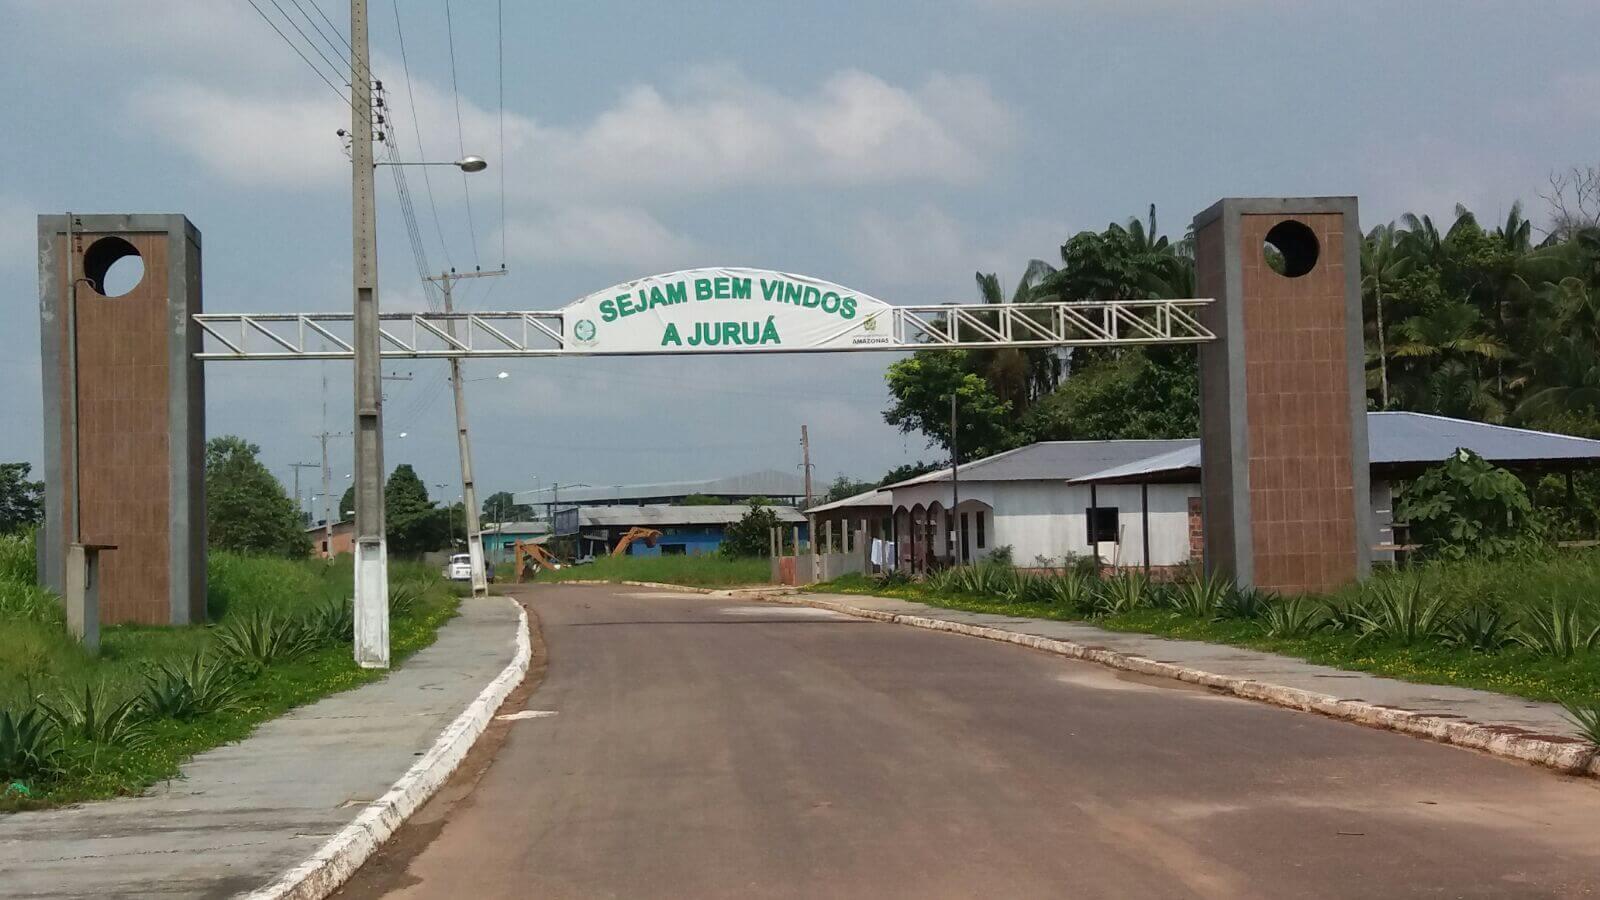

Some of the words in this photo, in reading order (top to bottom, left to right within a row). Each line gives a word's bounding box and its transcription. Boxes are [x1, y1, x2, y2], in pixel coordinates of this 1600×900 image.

[599, 281, 688, 322] SEJAM
[695, 277, 752, 301] BEM
[760, 279, 858, 320] VINDOS
[662, 323, 682, 346] A
[687, 315, 781, 346] JURUÁ
